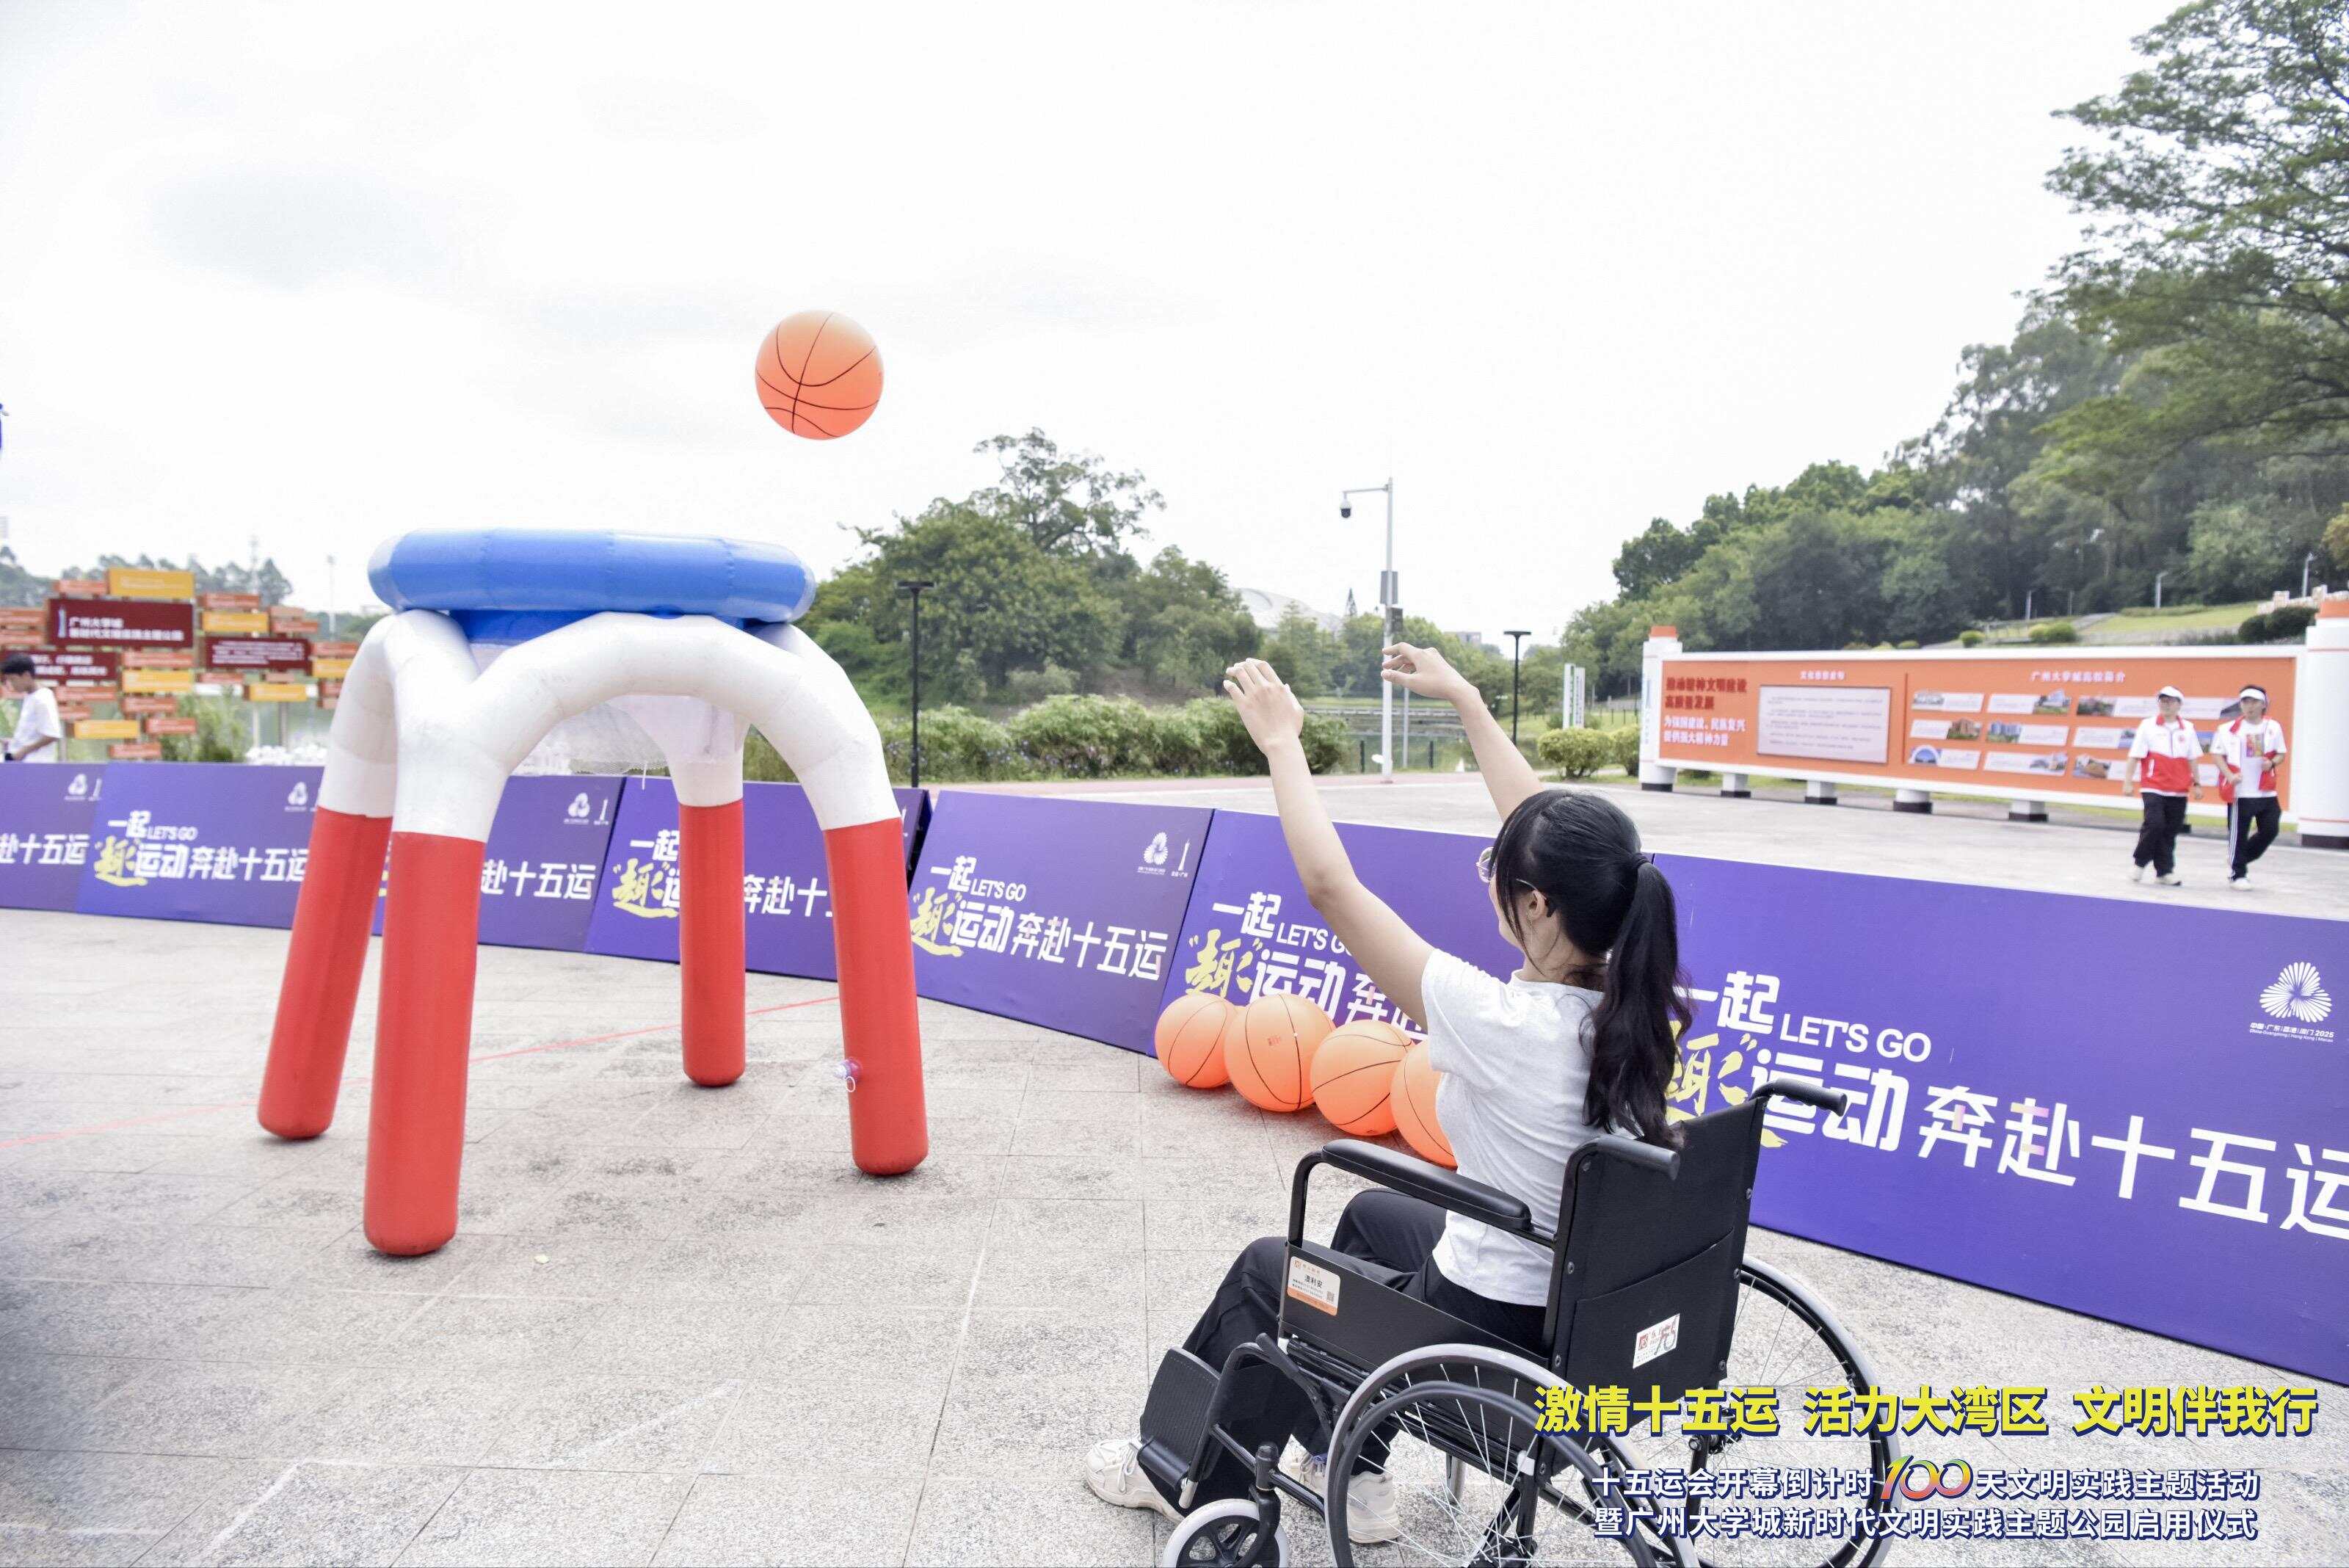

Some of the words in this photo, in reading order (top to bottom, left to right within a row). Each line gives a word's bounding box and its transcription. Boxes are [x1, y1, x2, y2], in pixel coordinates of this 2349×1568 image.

[107, 810, 151, 838] 一起
[178, 826, 199, 841] GO
[744, 874, 833, 917] 奔赴十
[930, 855, 978, 893] 一起
[970, 879, 1005, 899] LET'S
[1005, 883, 1027, 902] GO
[1212, 891, 1282, 939] 一起
[1276, 922, 1328, 951] LET'S
[1330, 934, 1352, 956] G
[1672, 970, 1781, 1034] 一起
[1779, 1013, 1869, 1053] LET'S
[1876, 1028, 1932, 1063] GO
